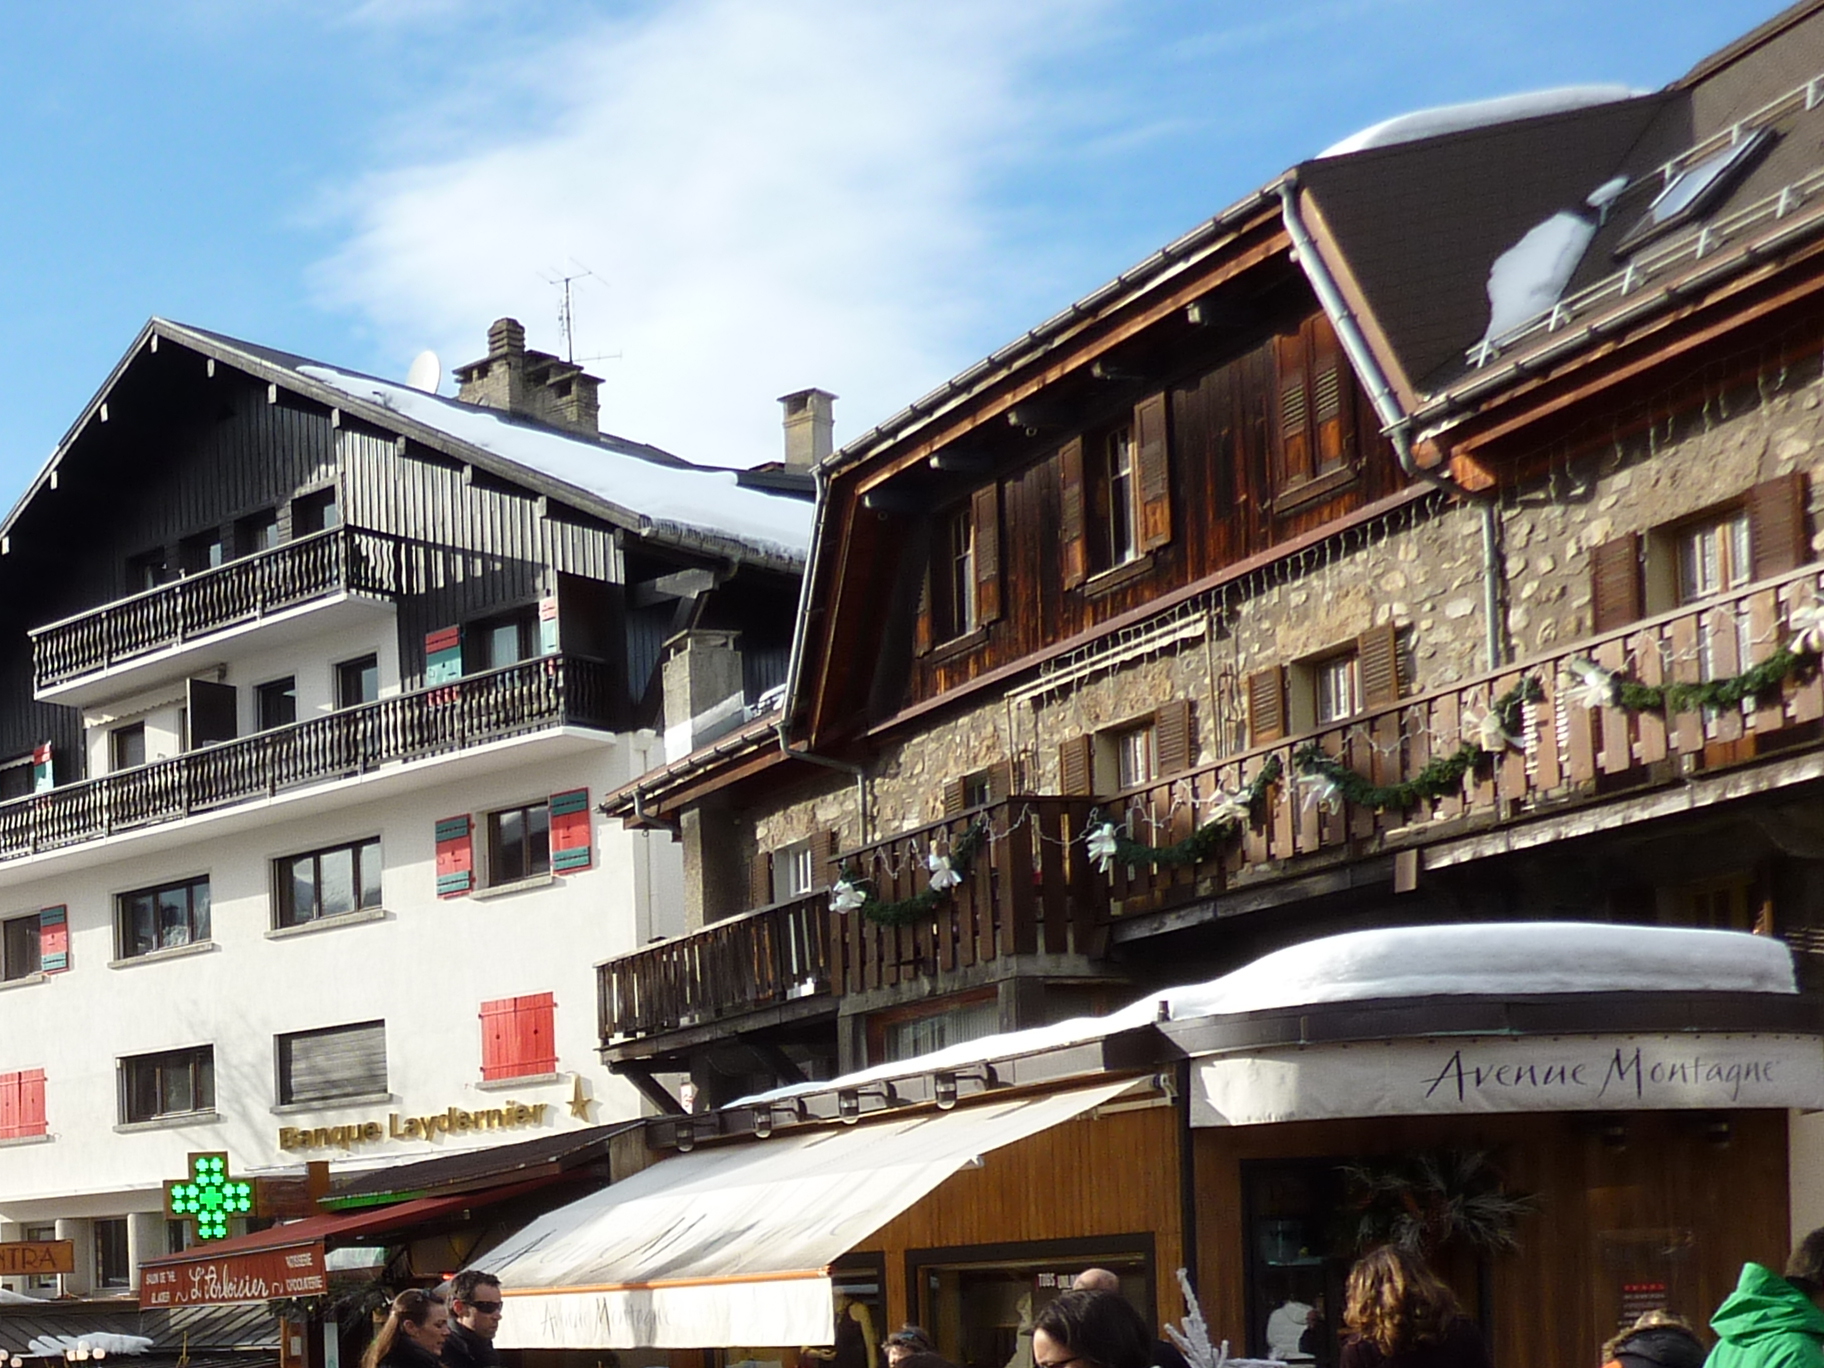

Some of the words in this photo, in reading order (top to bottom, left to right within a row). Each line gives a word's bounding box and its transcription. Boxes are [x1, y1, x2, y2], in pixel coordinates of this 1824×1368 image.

[1420, 1050, 1587, 1102] Avenue
[1597, 1048, 1774, 1102] Montagne
[279, 1120, 383, 1150] Banque
